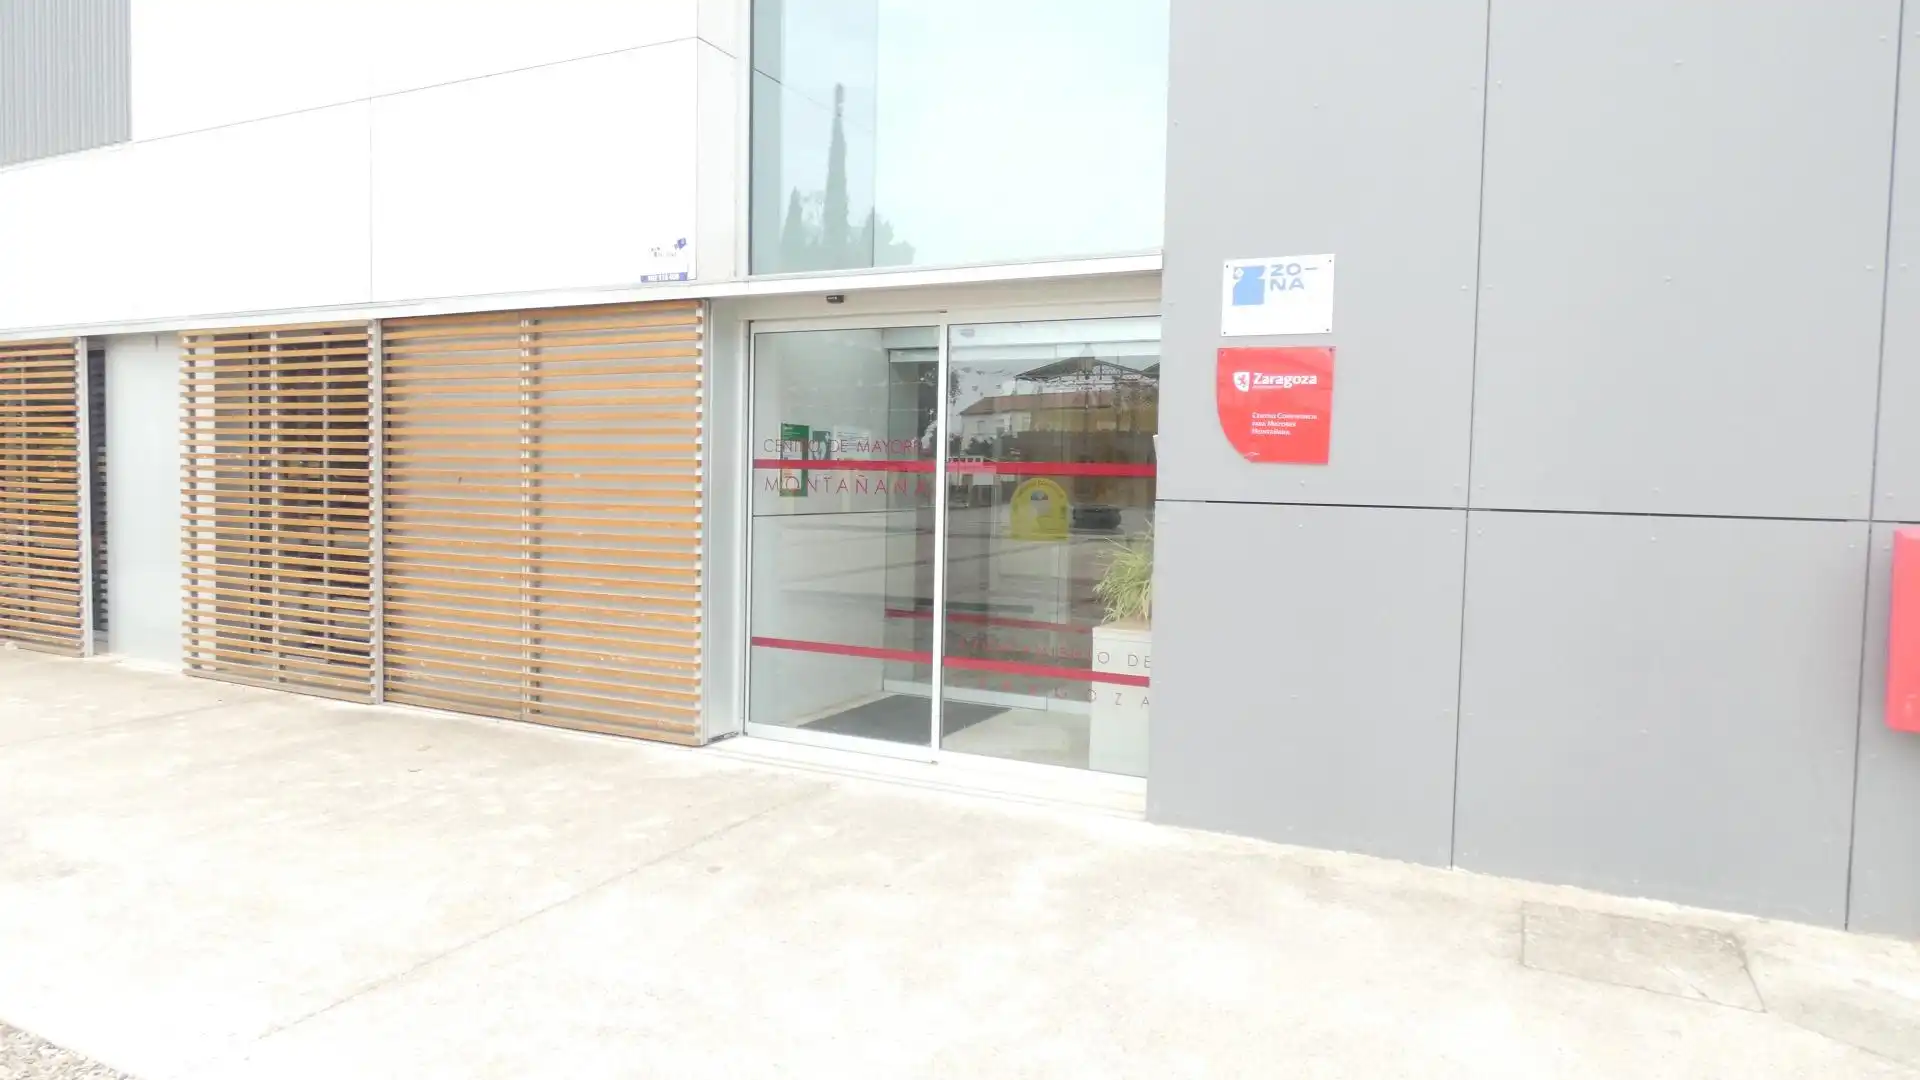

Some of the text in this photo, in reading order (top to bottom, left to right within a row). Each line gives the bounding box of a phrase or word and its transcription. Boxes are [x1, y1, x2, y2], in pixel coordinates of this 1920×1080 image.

[1270, 277, 1305, 291] NA
[1253, 372, 1318, 389] Zaragoza
[829, 438, 848, 453] DE
[857, 438, 934, 456] MAYOR
[765, 474, 927, 497] MONTAÑANA
[1127, 654, 1151, 668] DE
